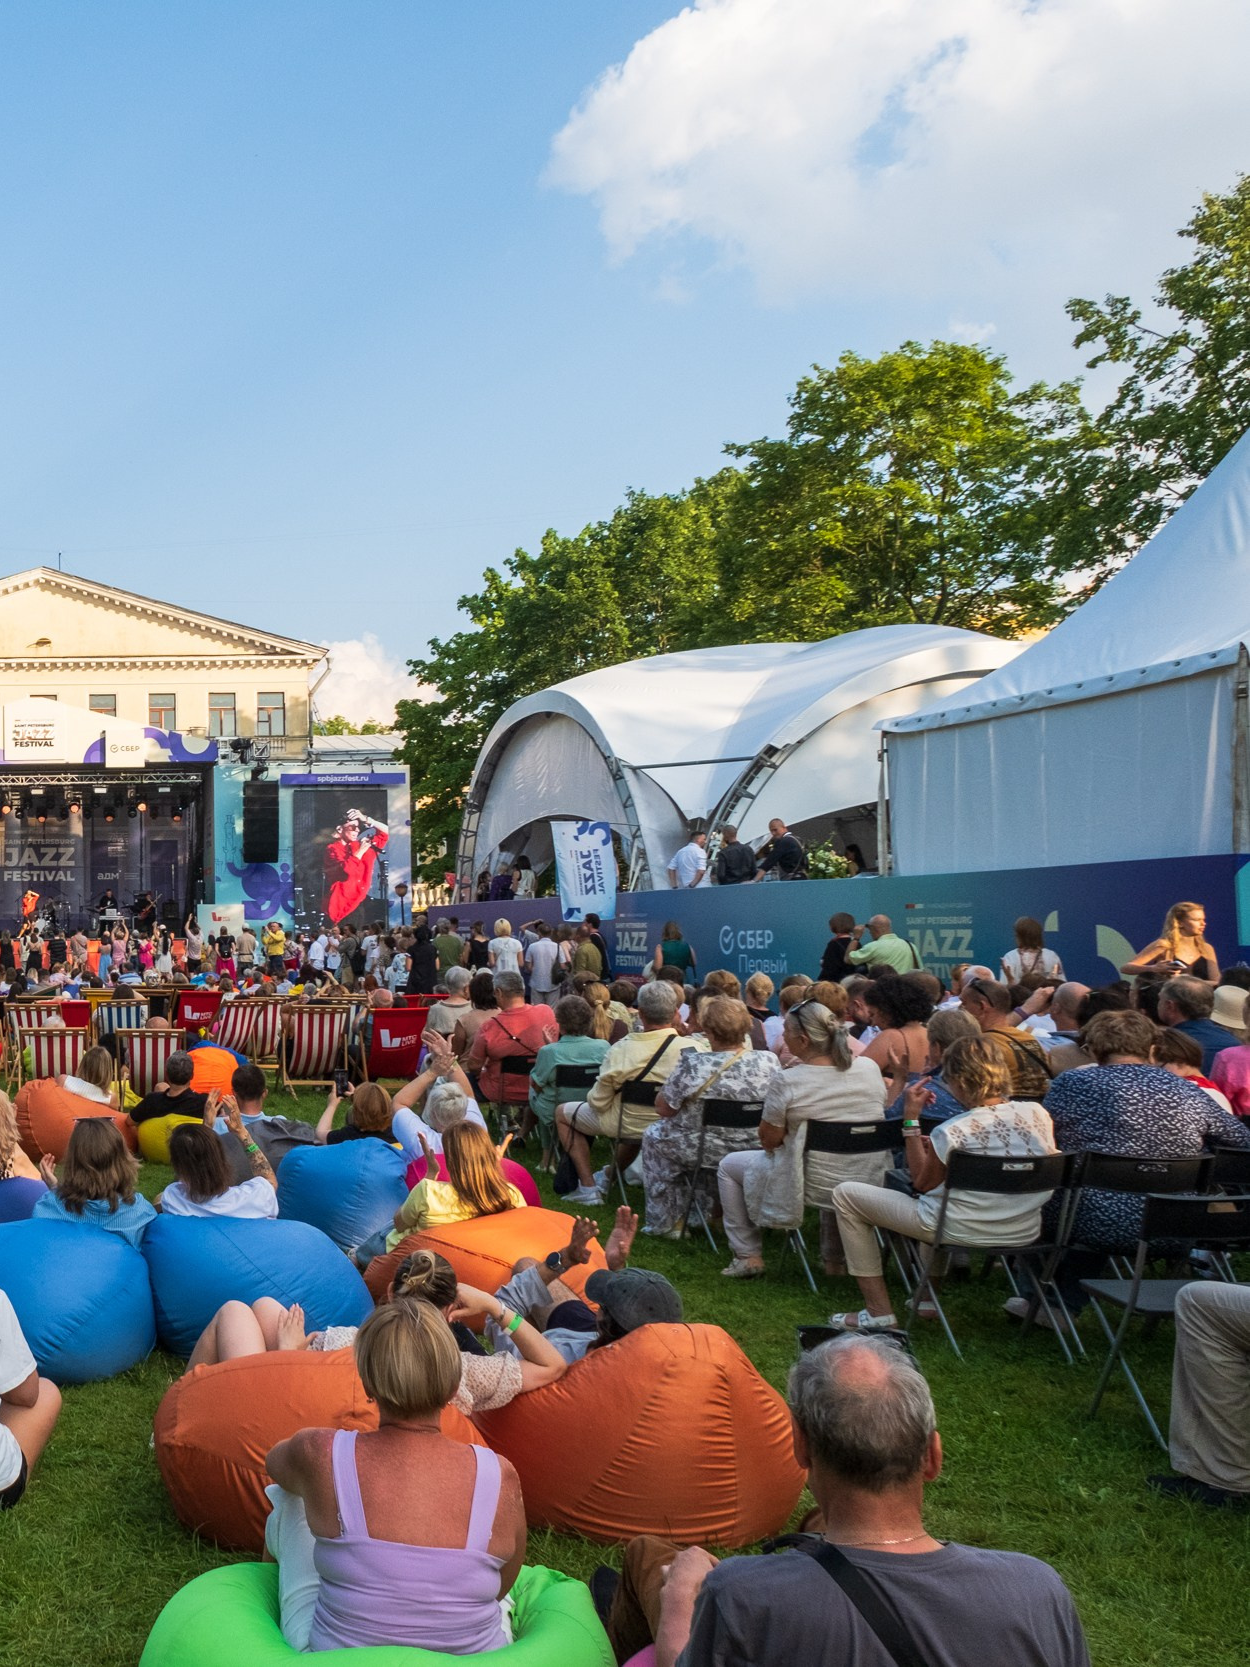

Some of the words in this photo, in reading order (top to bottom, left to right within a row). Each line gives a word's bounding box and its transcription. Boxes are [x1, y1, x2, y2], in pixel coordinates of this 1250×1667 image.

[317, 774, 369, 784] spbjazzfest.ru
[4, 847, 76, 867] JAZZ
[3, 870, 76, 882] FESTIVAL
[615, 931, 648, 952] JAZZ
[737, 929, 774, 950] СБЕР
[615, 954, 647, 967] FESTIVAL
[738, 953, 788, 974] Первый
